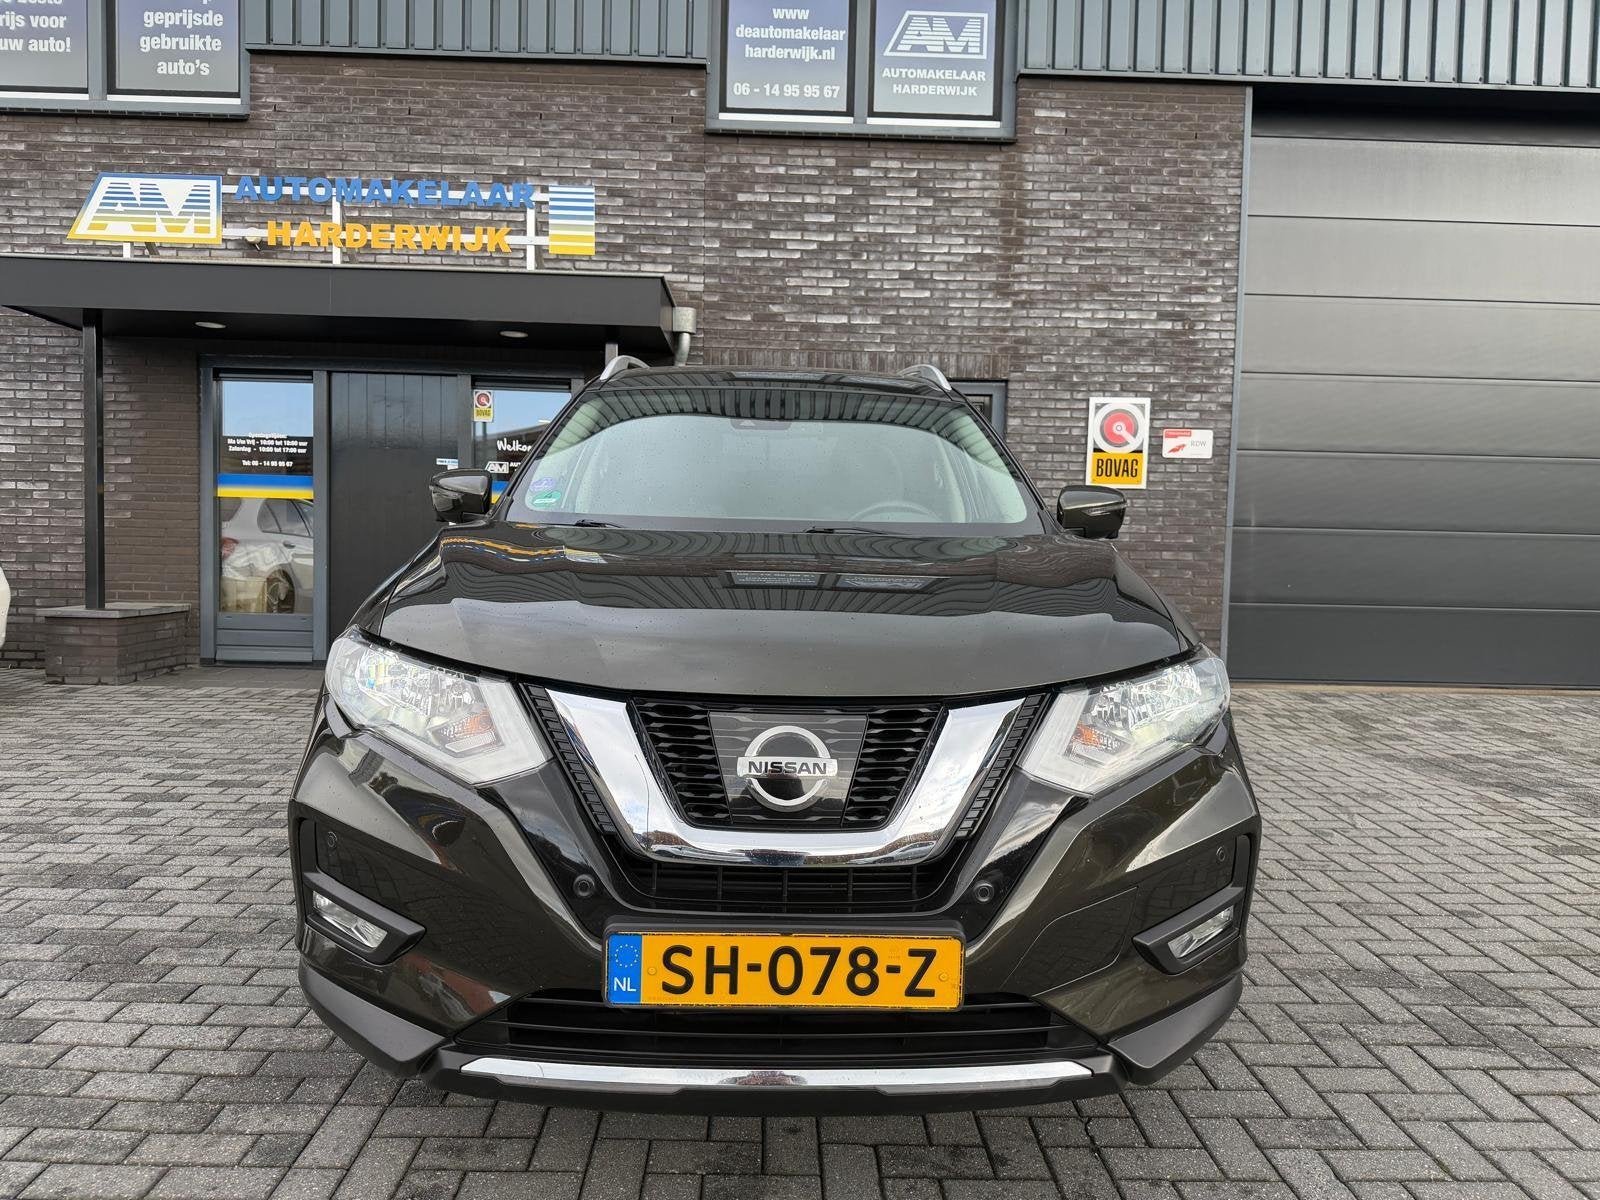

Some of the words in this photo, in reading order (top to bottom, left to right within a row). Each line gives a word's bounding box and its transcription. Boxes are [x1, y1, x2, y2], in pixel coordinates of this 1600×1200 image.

[29, 15, 67, 28] voor
[143, 9, 224, 29] geprijsde
[772, 8, 810, 20] www
[735, 24, 846, 41] deautomakelaar
[896, 16, 982, 54] AM
[28, 36, 71, 53] auto!
[140, 33, 222, 53] gebruikte
[744, 44, 836, 62] harderwijk.nl
[156, 59, 210, 76] auto's
[882, 67, 987, 81] AUTOMAKELAAR
[733, 82, 751, 96] 06
[763, 83, 780, 97] 14
[783, 84, 800, 97] 95
[803, 84, 820, 98] 95
[823, 85, 840, 99] 67
[892, 84, 978, 97] HARDERWIJK
[235, 175, 536, 209] AUTOMAKELAAR
[87, 182, 211, 235] AM
[267, 220, 513, 253] HARDERWIJK
[1096, 458, 1139, 478] BOVAG
[748, 761, 827, 775] NISSAN
[661, 944, 938, 998] SH-078-Z
[613, 976, 637, 992] NL
